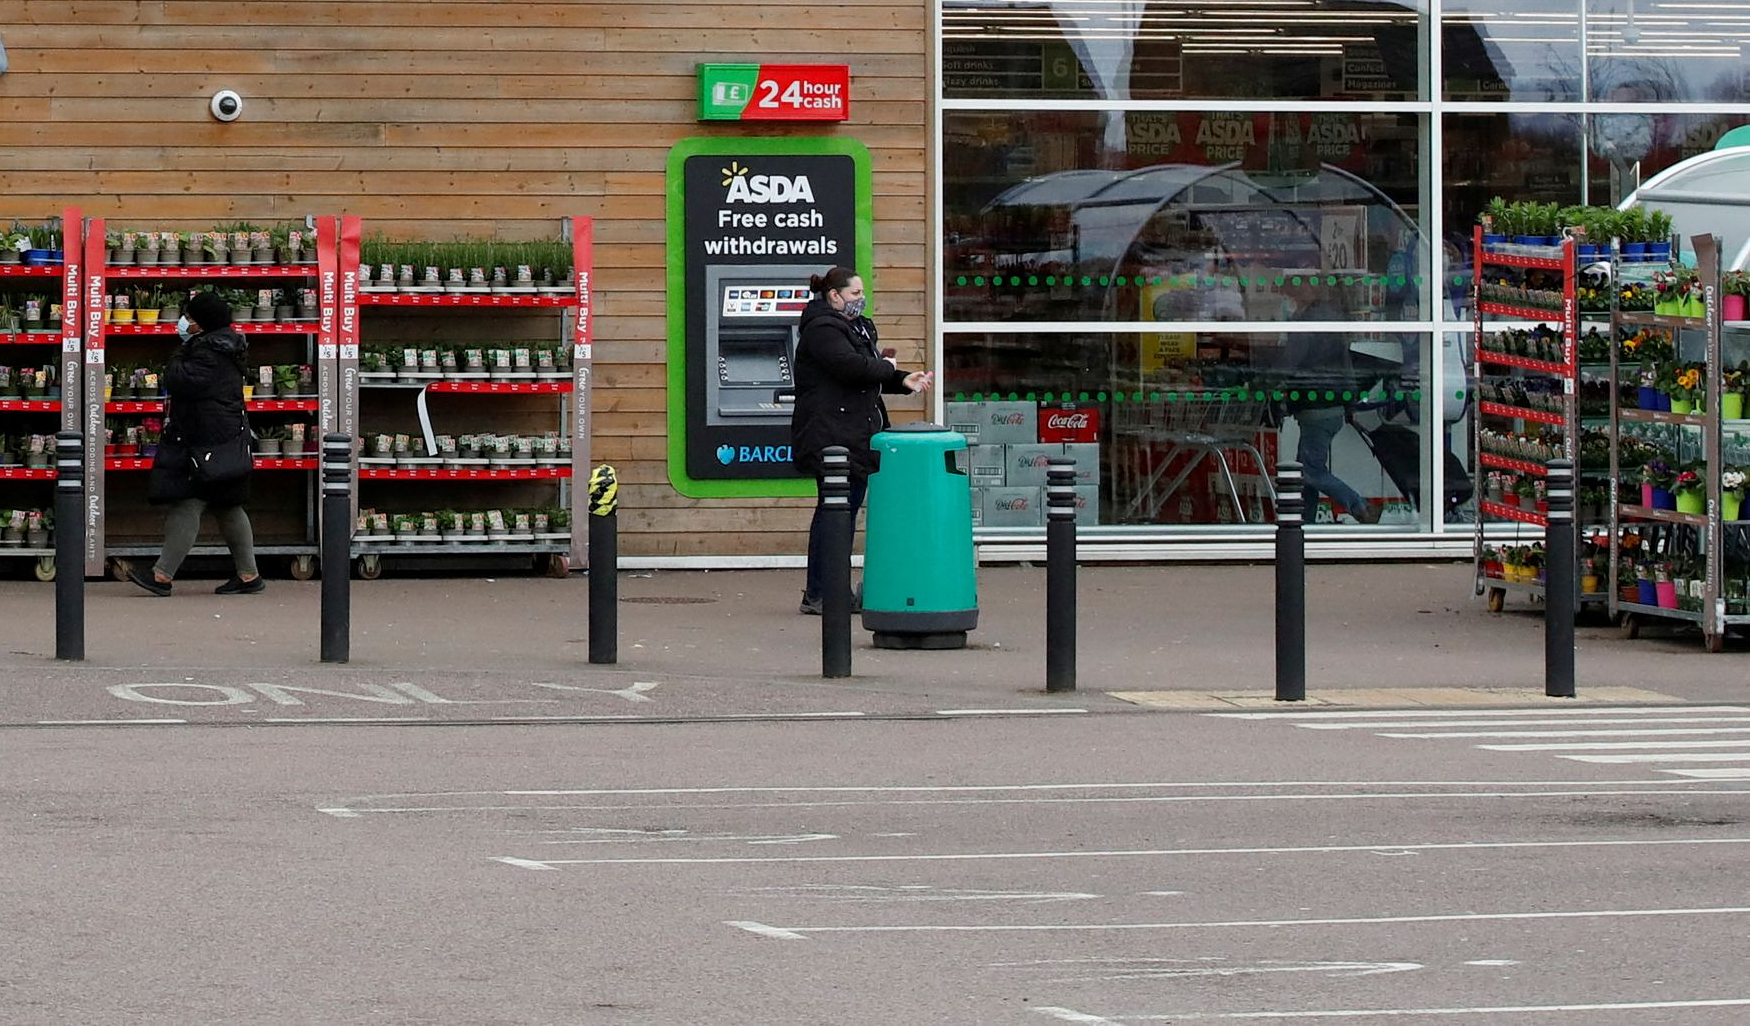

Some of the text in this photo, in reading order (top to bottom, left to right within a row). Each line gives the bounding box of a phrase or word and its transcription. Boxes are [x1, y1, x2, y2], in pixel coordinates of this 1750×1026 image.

[1053, 58, 1068, 77] 6
[758, 80, 803, 108] 24
[804, 81, 841, 94] hour
[803, 94, 842, 108] cash
[1195, 120, 1256, 145] ASDA
[1307, 124, 1360, 145] ASDA
[1129, 144, 1170, 155] PRICE
[1206, 146, 1244, 159] PRICE
[726, 175, 815, 203] ASDA
[718, 209, 823, 227] Free cash
[704, 236, 838, 255] withdrawals
[66, 264, 77, 326] Multi Buy
[323, 272, 334, 333] Multi Buy
[343, 272, 355, 333] Multi Buy
[578, 272, 588, 333] Multi Buy
[89, 276, 101, 338] Multi Buy
[739, 446, 793, 462] BARCL
[107, 680, 661, 706] ONLY
